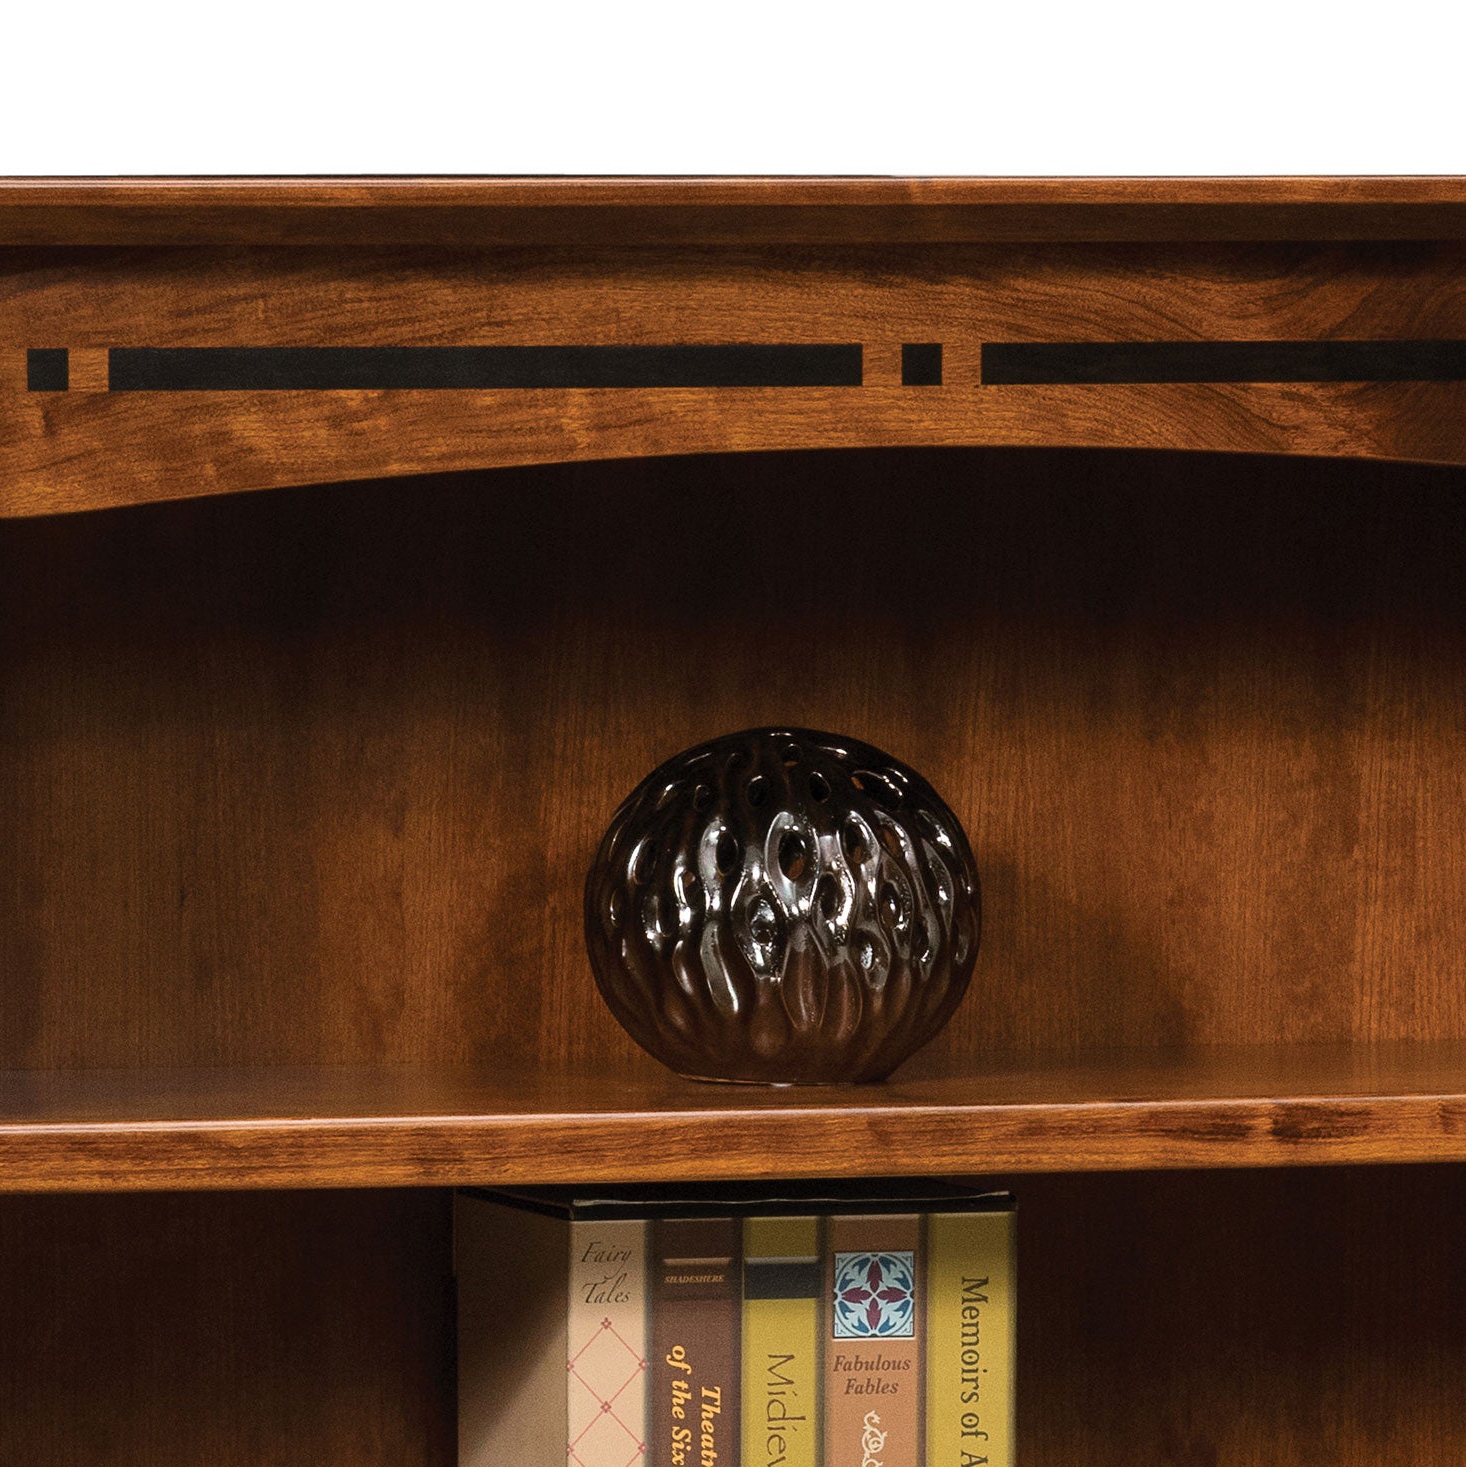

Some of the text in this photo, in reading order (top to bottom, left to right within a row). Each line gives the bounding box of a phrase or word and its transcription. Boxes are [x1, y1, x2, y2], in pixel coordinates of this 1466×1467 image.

[581, 1241, 632, 1277] Fairy
[582, 1272, 631, 1304] Tales
[959, 1275, 989, 1405] Memoirs
[666, 1345, 692, 1375] of
[833, 1355, 911, 1372] Fabulous
[671, 1380, 692, 1420] the
[844, 1378, 899, 1396] Fables
[959, 1412, 989, 1441] of
